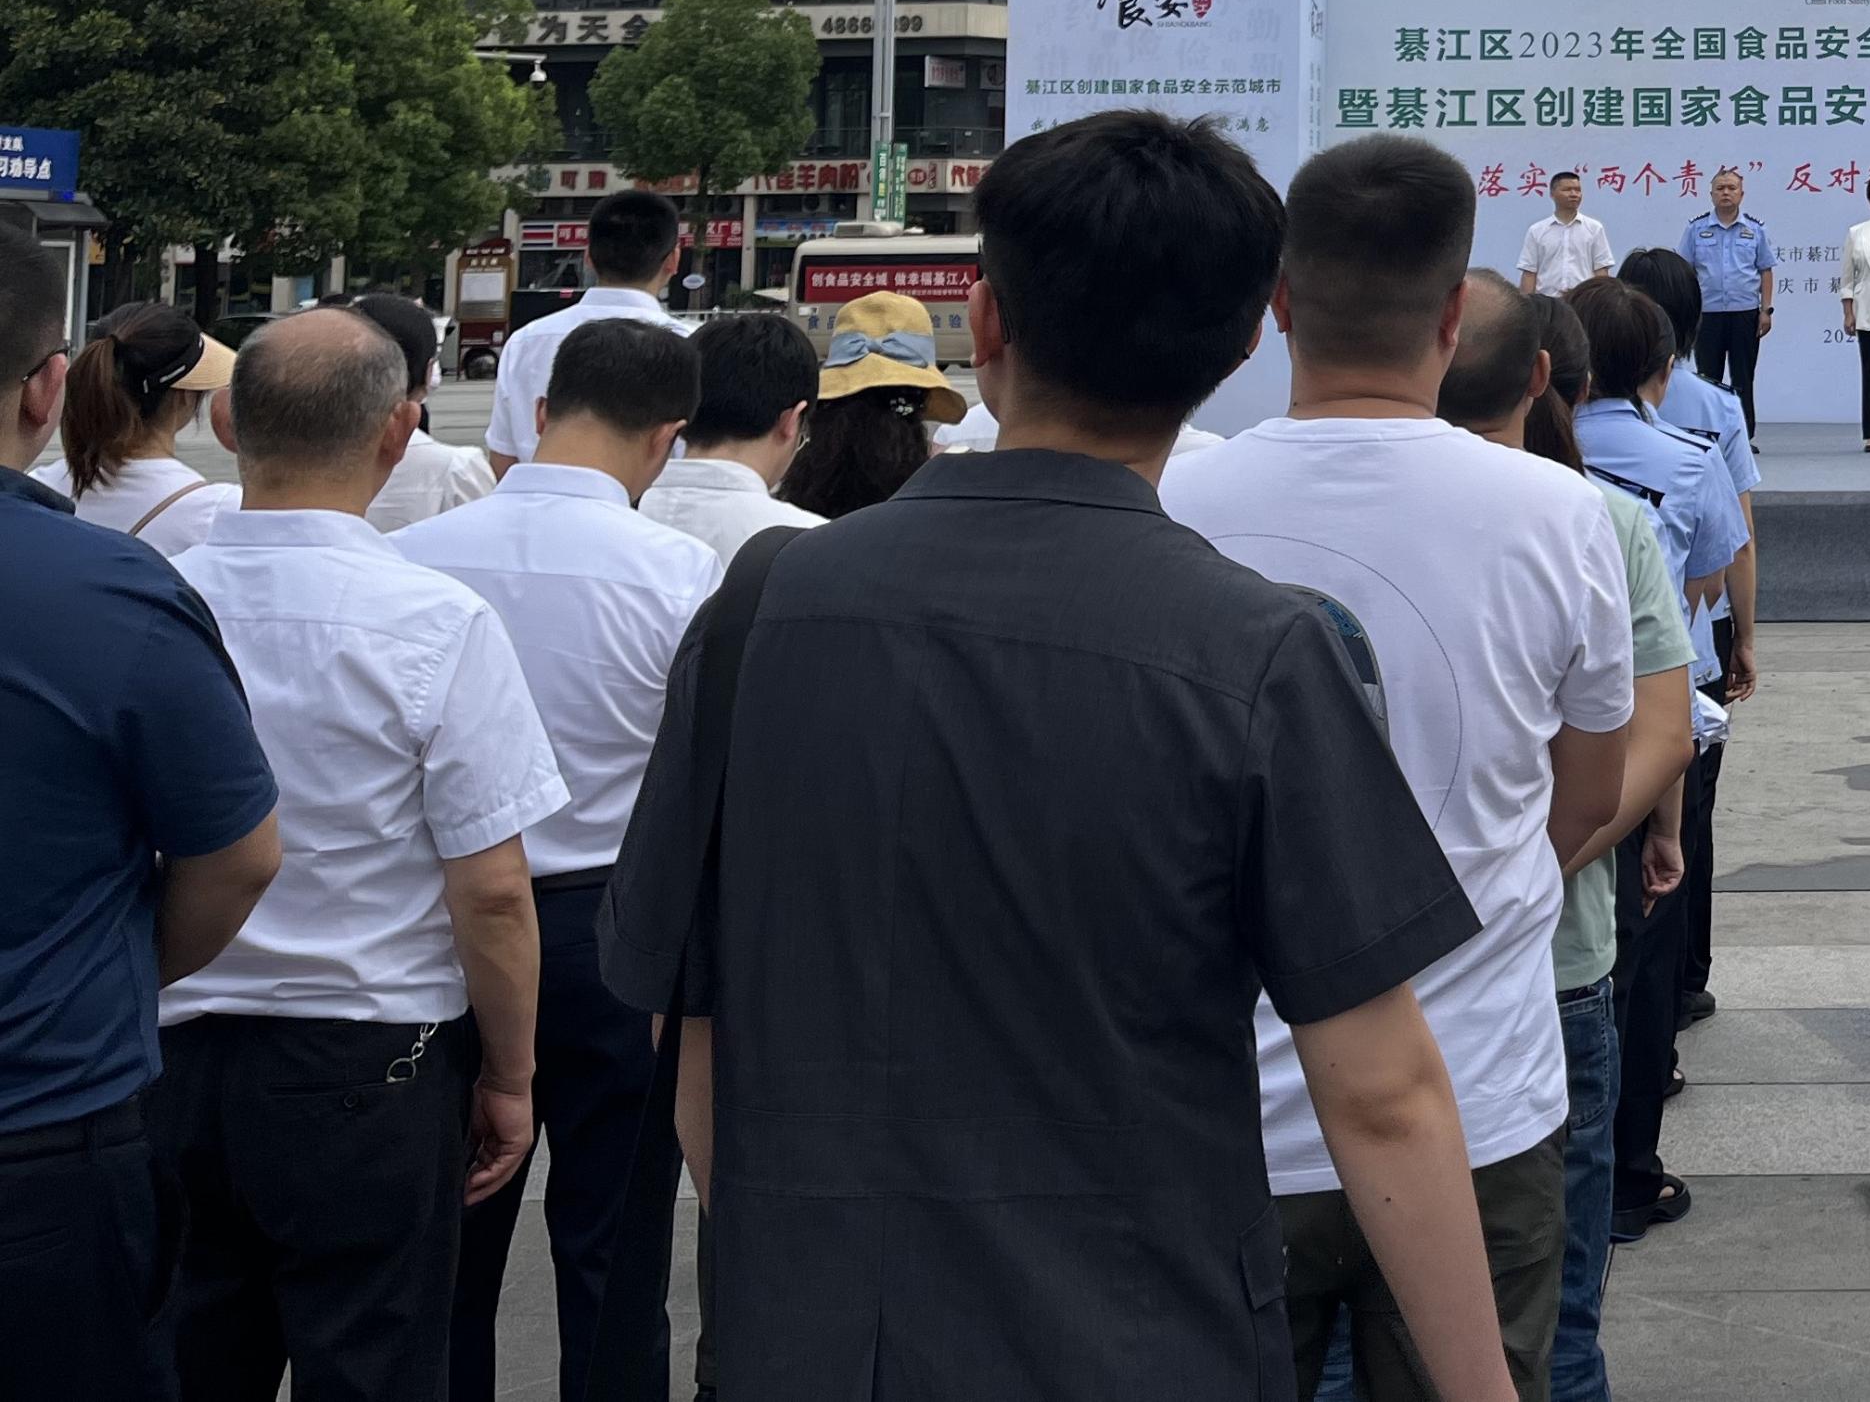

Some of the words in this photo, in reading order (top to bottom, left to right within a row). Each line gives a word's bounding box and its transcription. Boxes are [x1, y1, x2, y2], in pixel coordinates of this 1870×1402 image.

[1025, 79, 1282, 95] 綦江区创建国家食品安全示范城市
[811, 271, 888, 287] 创食品安全城
[894, 270, 972, 287] 做幸福綦江人
